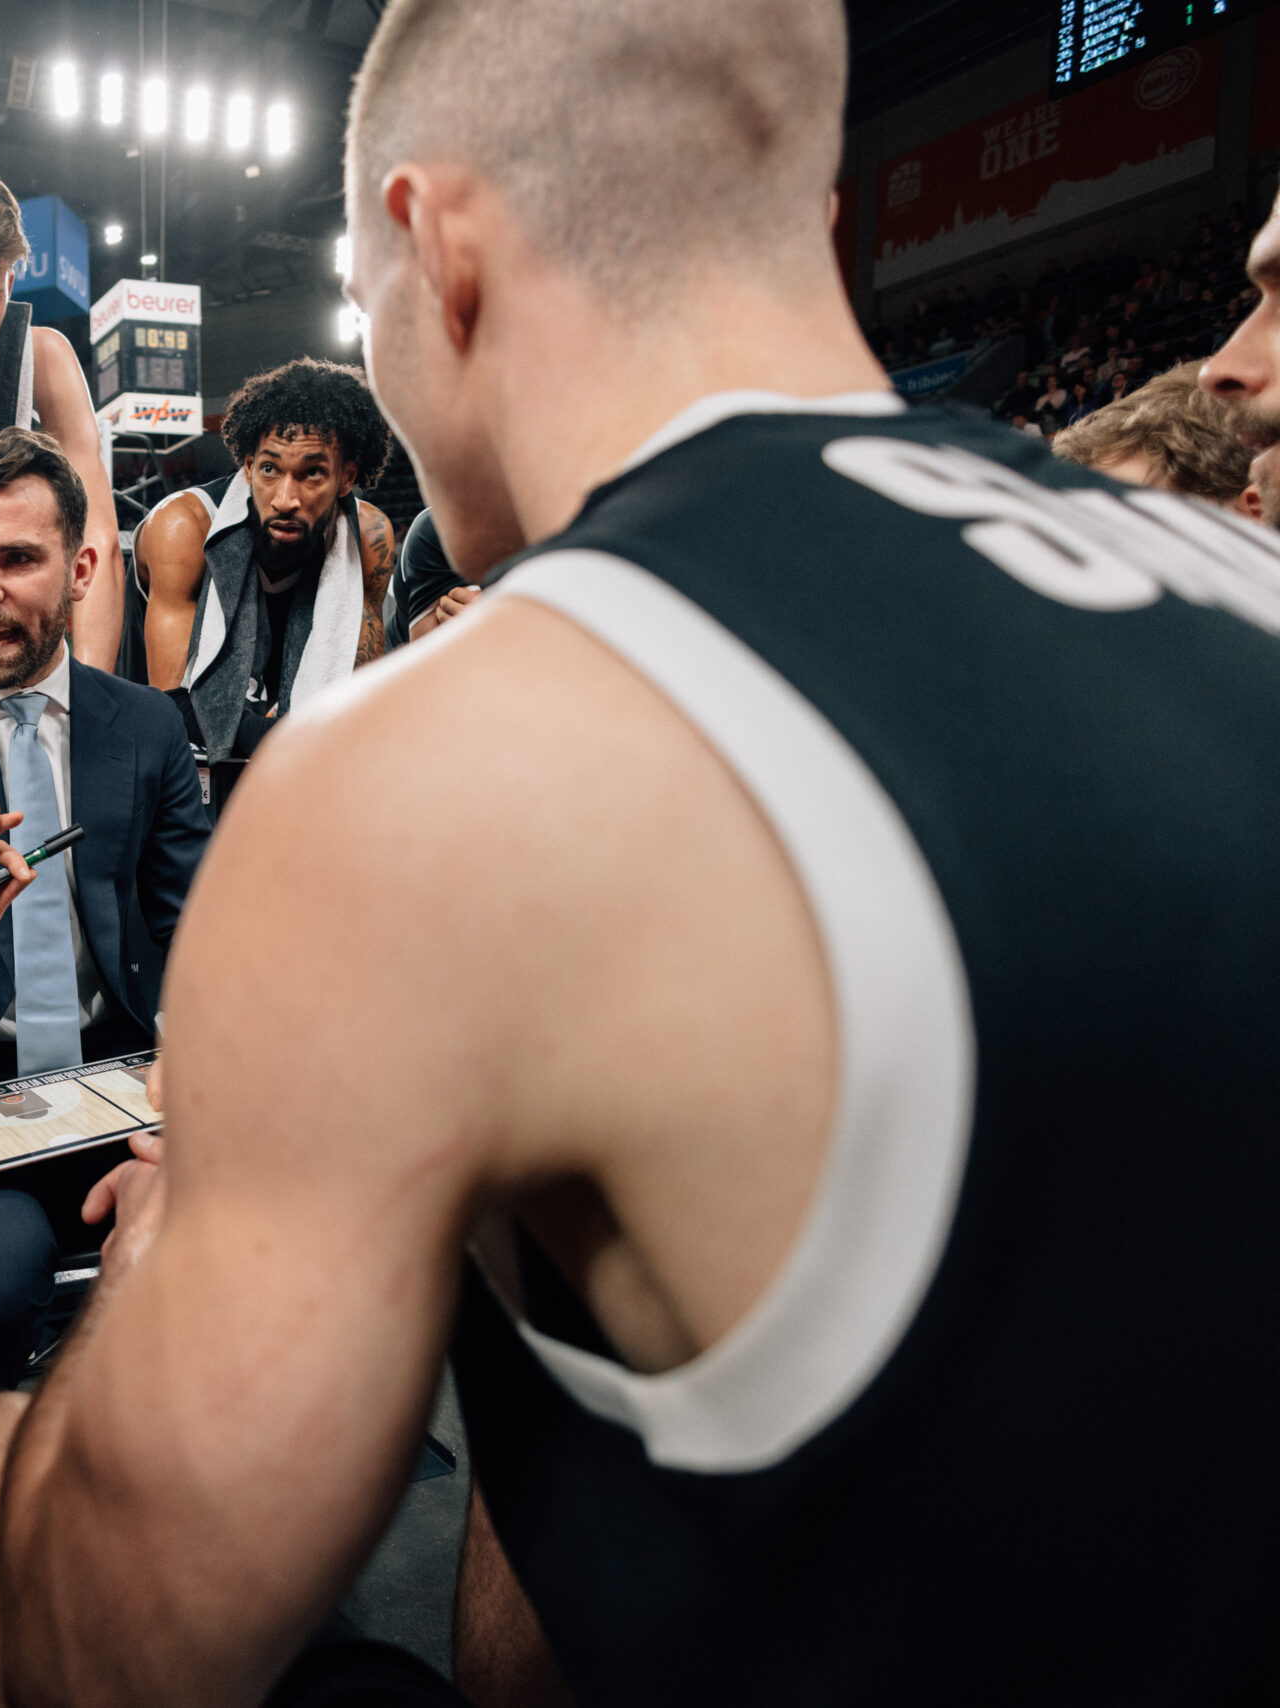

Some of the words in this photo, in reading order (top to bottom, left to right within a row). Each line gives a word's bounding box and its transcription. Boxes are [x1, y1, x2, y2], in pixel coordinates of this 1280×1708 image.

[982, 117, 1016, 146] WE
[1020, 100, 1063, 133] ARE
[979, 117, 1062, 181] ONE
[126, 288, 196, 314] beurer
[5, 1078, 41, 1092] VEOLIA
[39, 1069, 82, 1085] TOWERS
